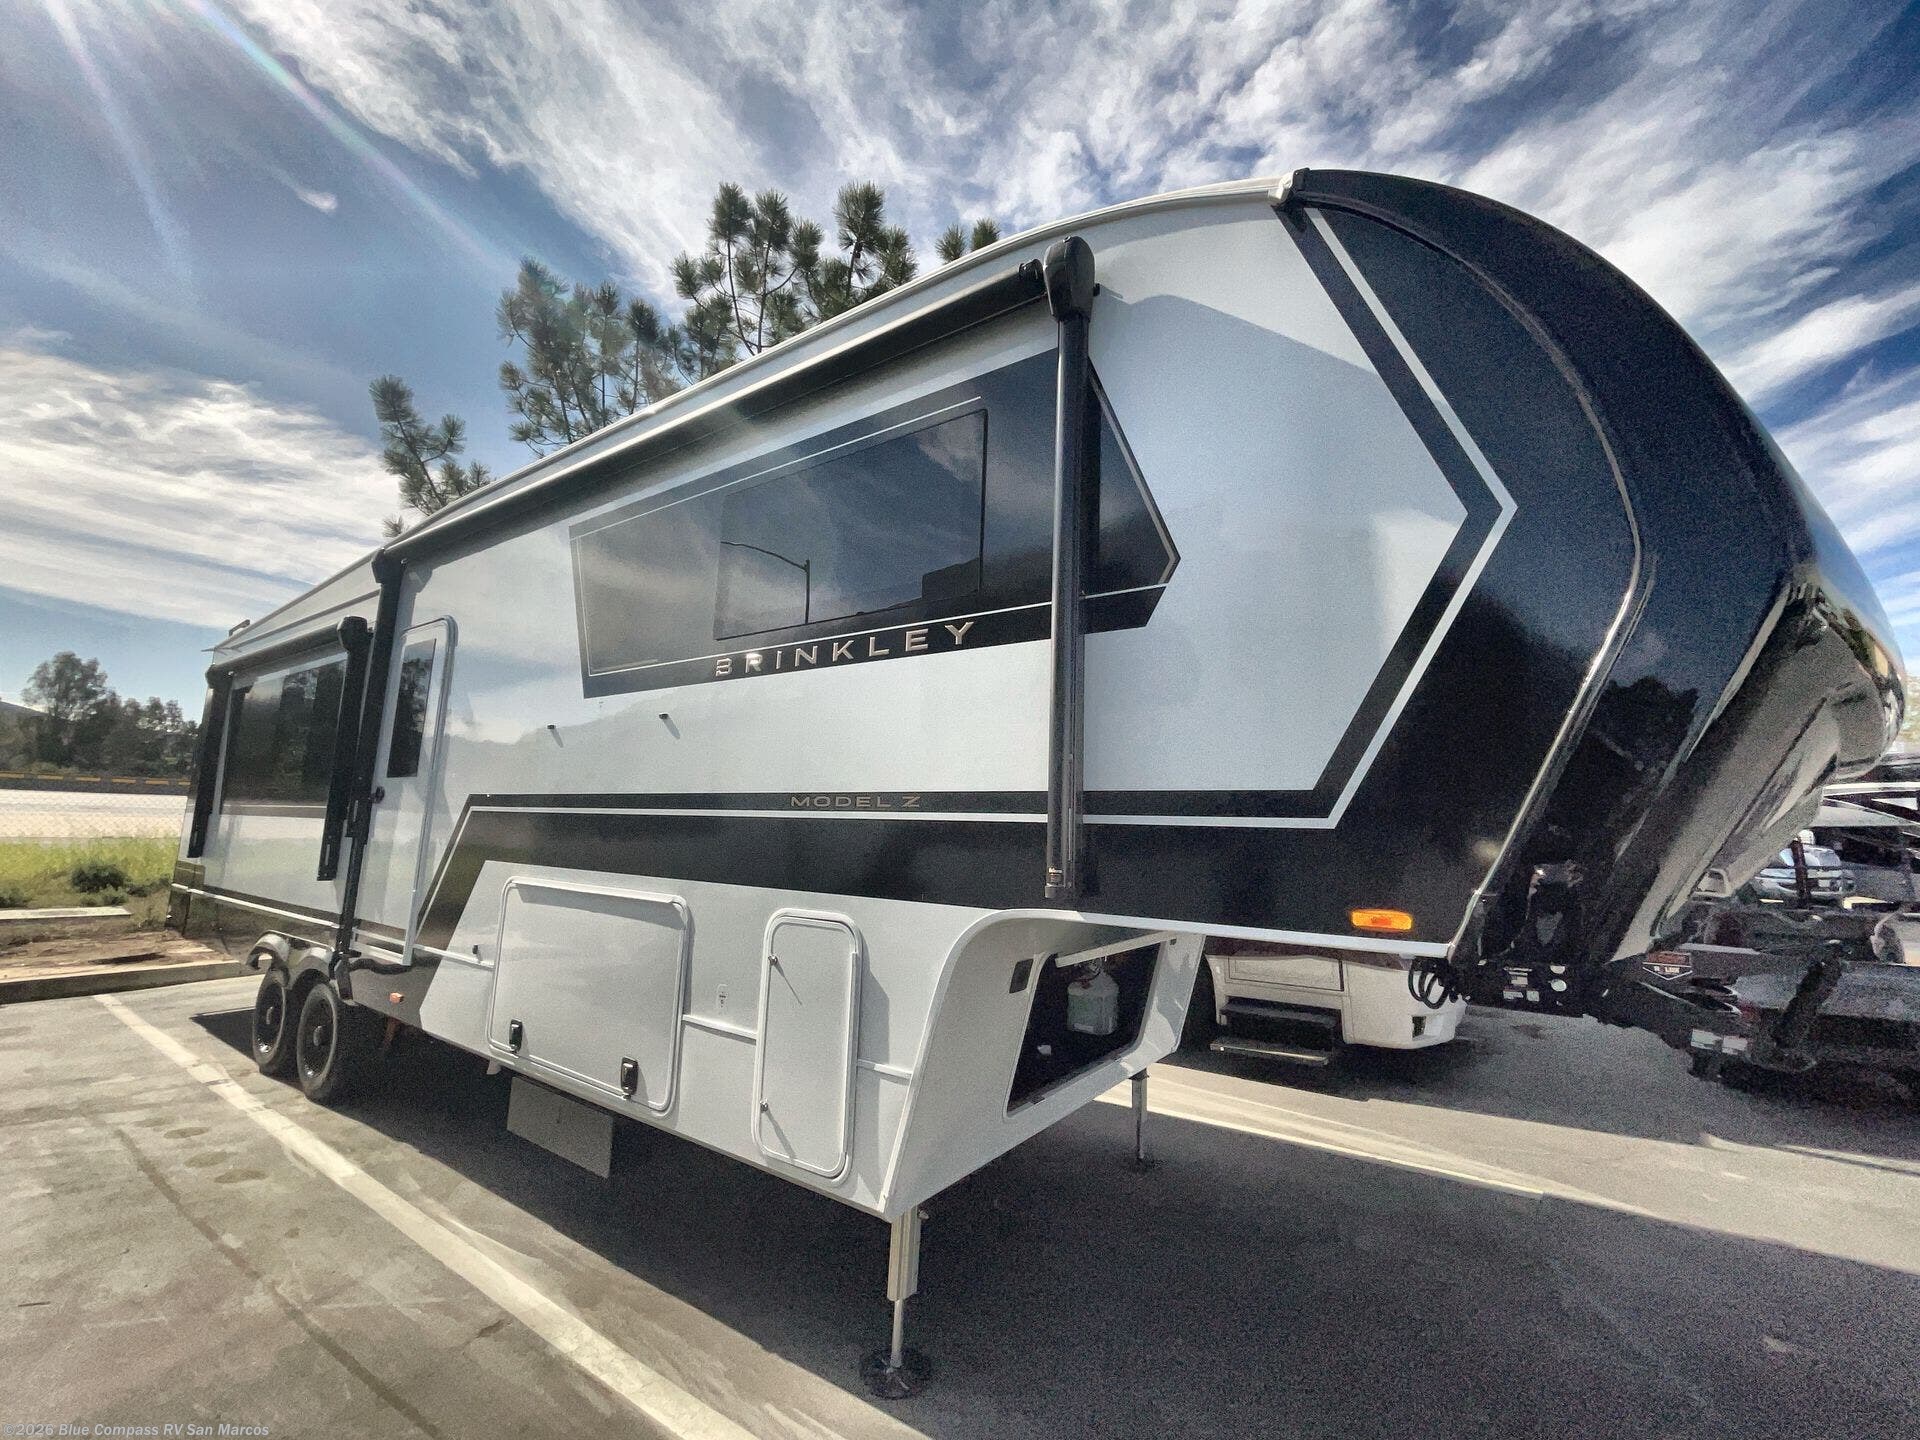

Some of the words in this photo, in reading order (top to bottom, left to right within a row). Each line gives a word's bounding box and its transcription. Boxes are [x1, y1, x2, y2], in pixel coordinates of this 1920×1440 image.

[715, 621, 974, 677] BRINKLEY
[790, 796, 891, 808] MODEL
[902, 796, 921, 808] Z
